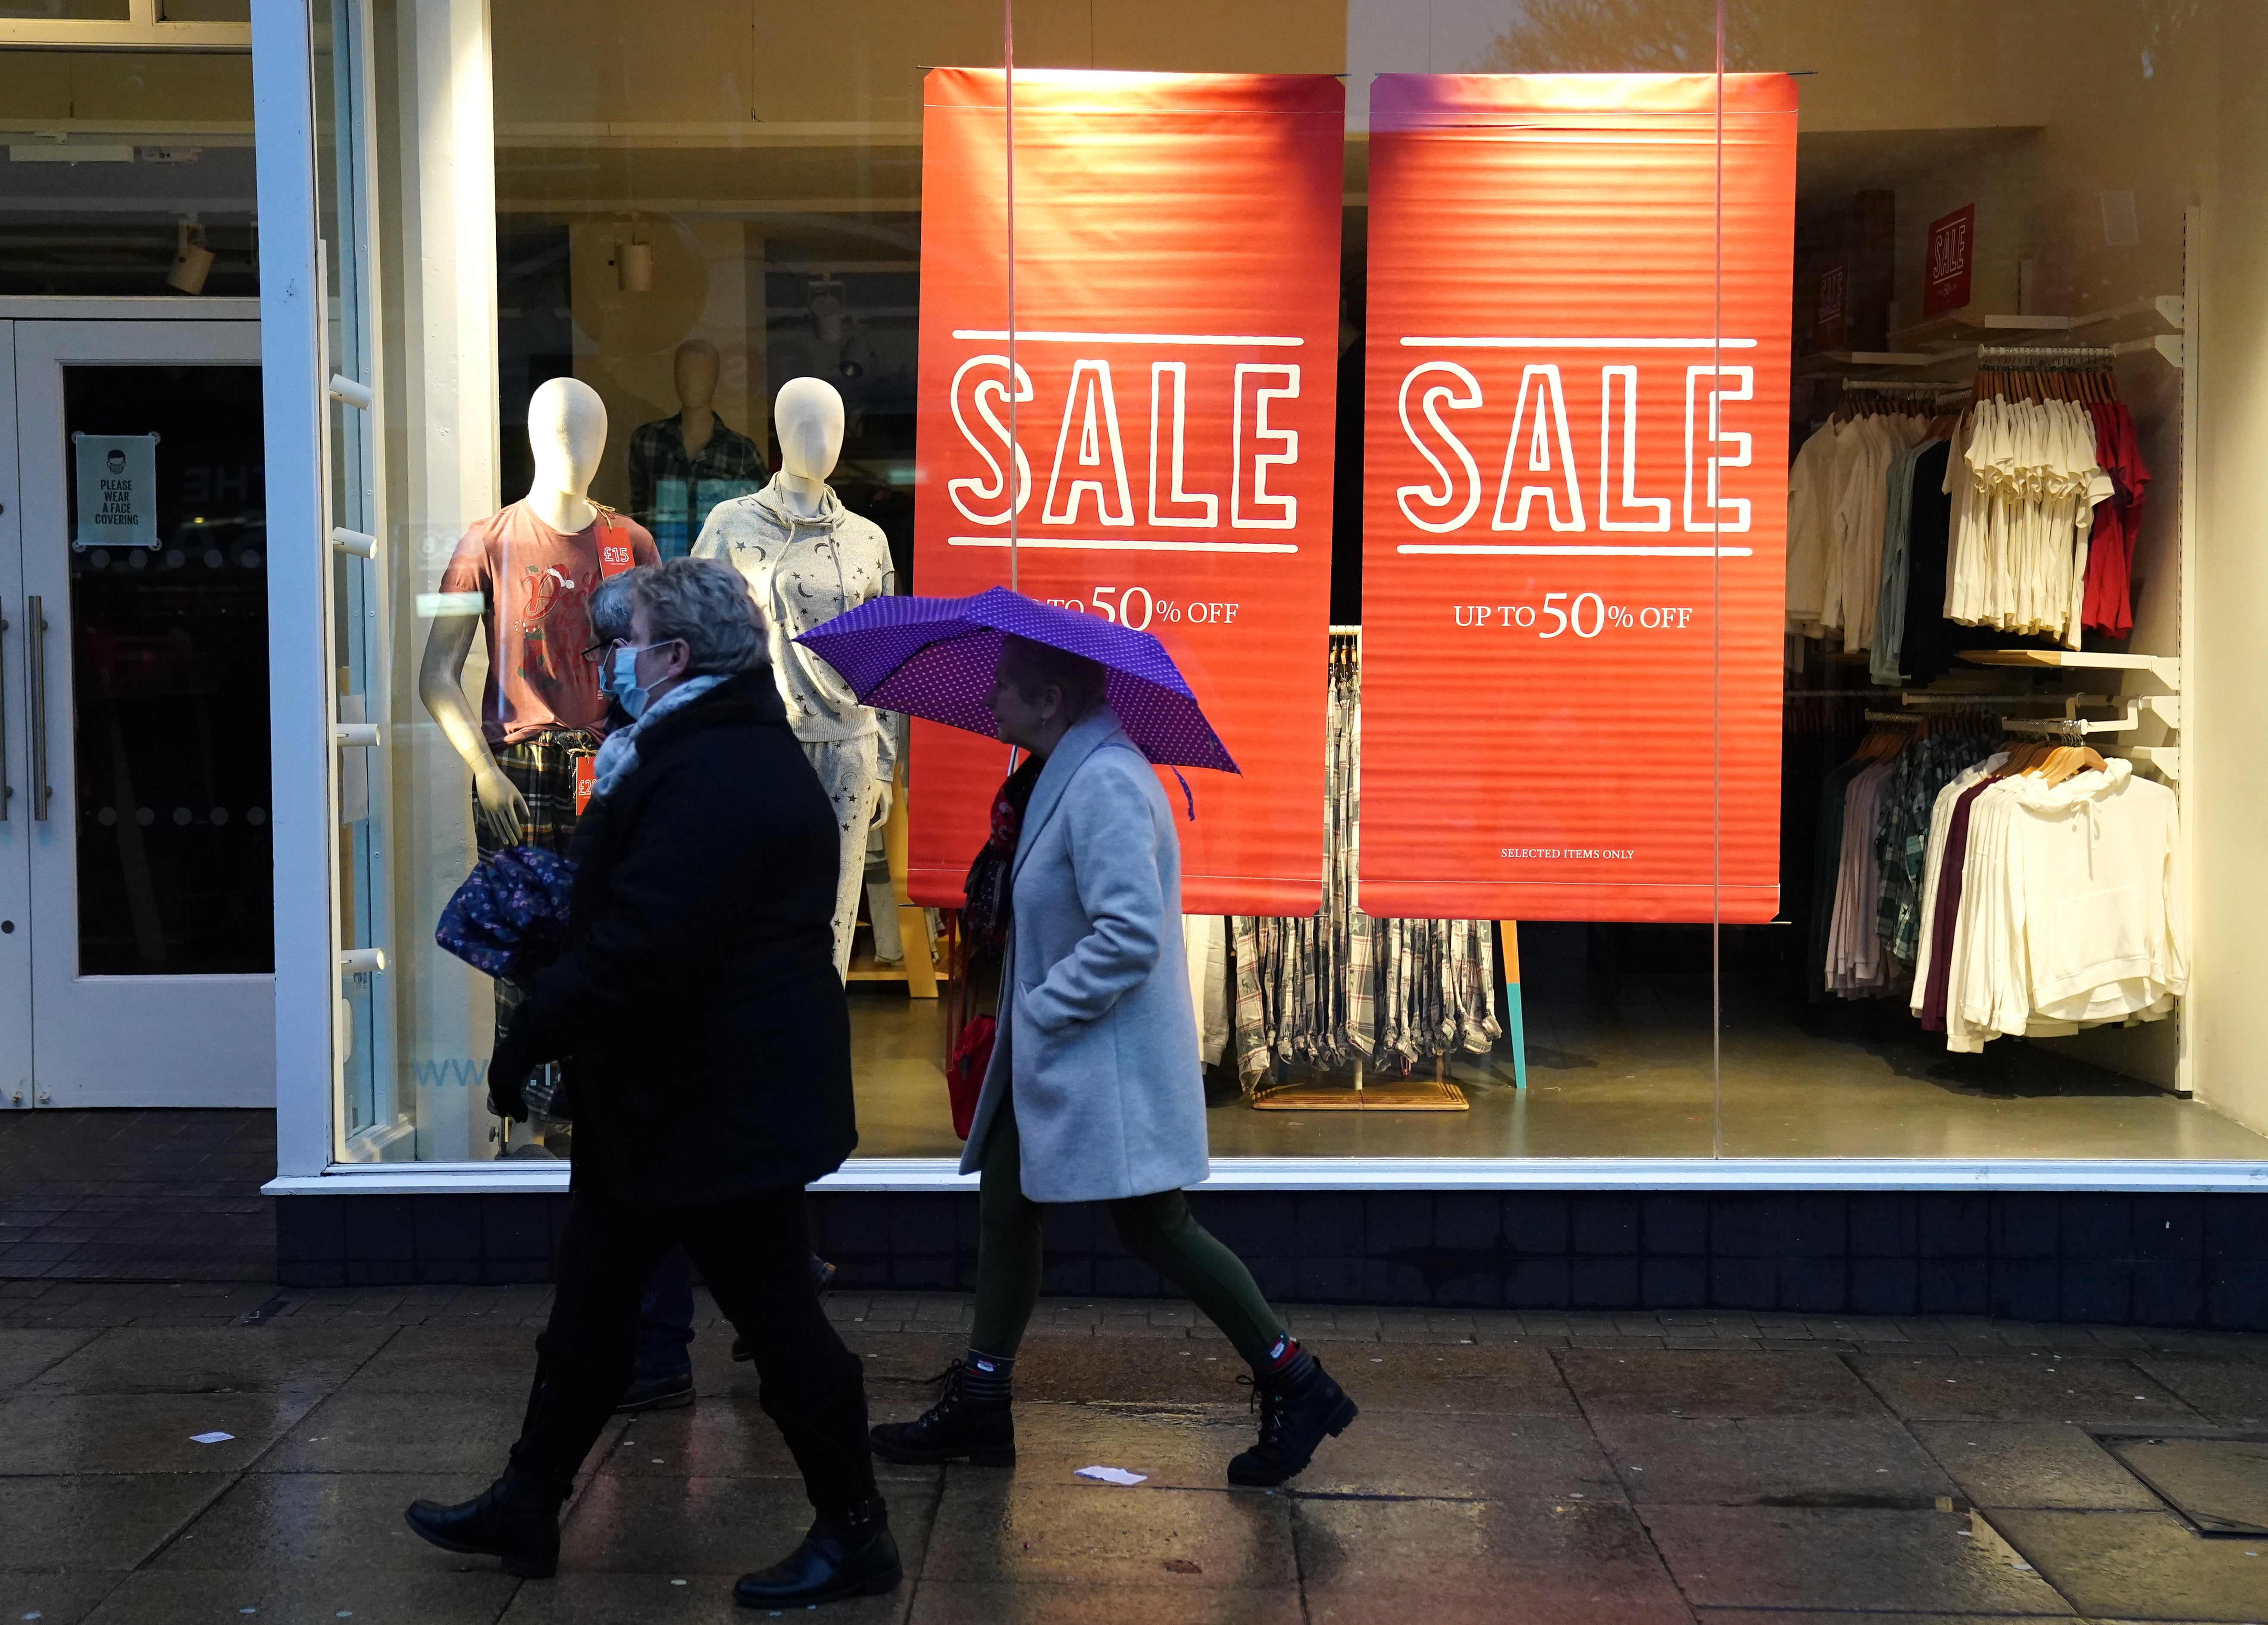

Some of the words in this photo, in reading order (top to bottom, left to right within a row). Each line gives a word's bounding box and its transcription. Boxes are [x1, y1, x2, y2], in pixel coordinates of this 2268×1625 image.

[1933, 224, 1966, 279] SALE
[948, 354, 1301, 529] SALE
[1396, 361, 1754, 533] SALE
[100, 479, 132, 491] PLEASE
[104, 490, 129, 502] WEAR
[102, 502, 109, 513] A
[110, 503, 131, 514] FACE
[95, 513, 138, 525] COVERING
[603, 547, 629, 562] £15
[1092, 586, 1181, 632] 50%
[1188, 602, 1239, 623] OFF
[1453, 605, 1491, 626] UP
[1497, 606, 1536, 627] TO
[1539, 592, 1633, 639] 50%
[1640, 607, 1692, 628] OFF
[1501, 848, 1561, 858] SELECTED
[1564, 849, 1600, 858] ITEMS
[1602, 850, 1635, 859] ONLY
